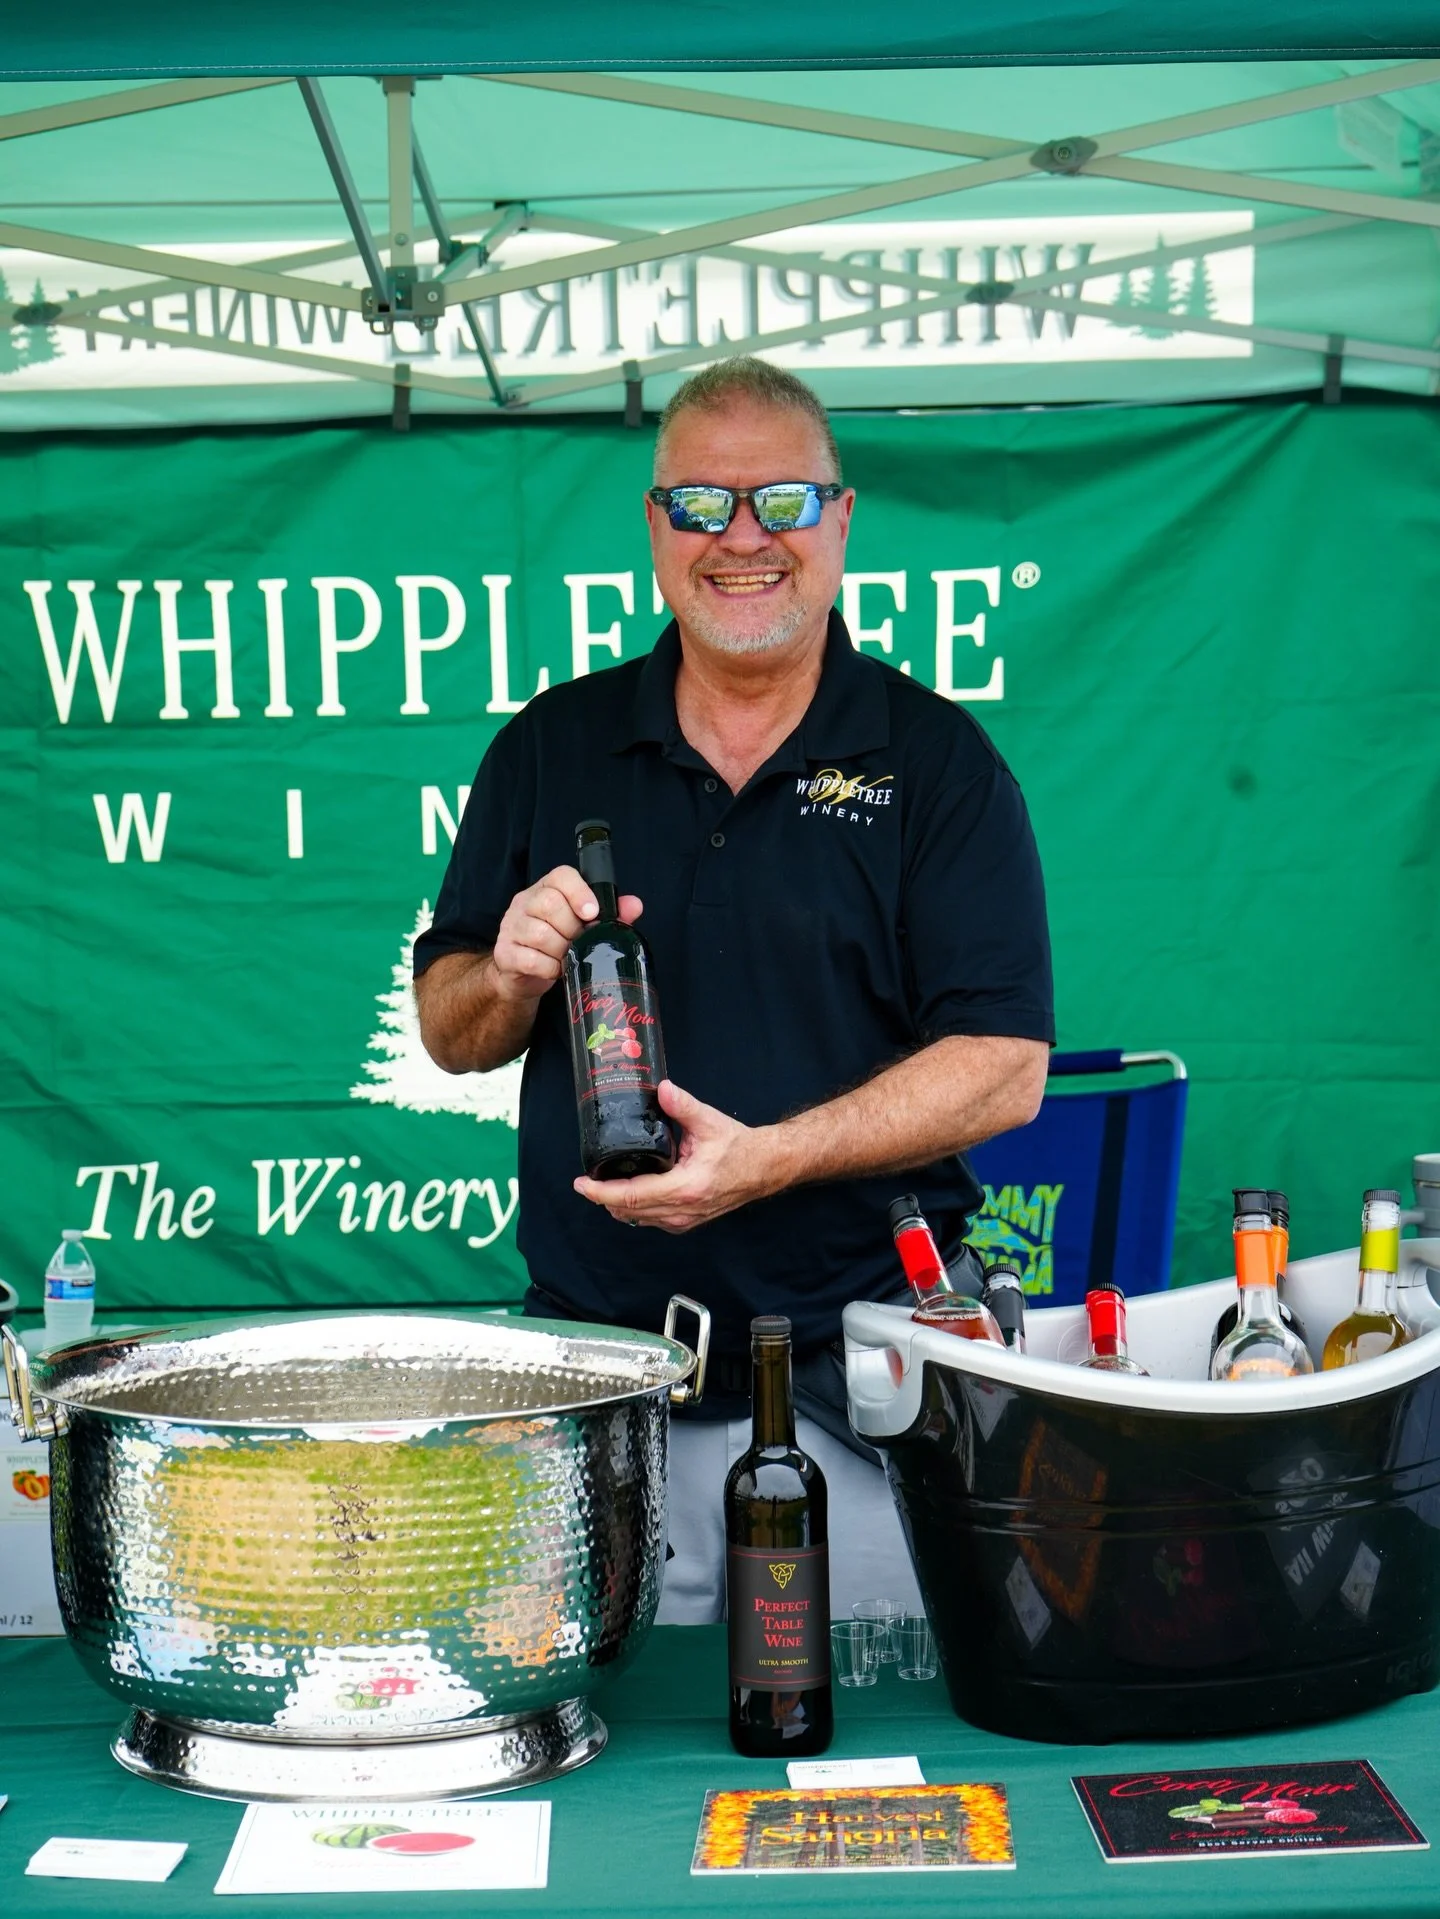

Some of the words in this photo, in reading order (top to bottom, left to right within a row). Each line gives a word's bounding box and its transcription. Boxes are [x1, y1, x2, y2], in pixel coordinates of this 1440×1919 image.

[796, 778, 893, 805] WHIPPLETREE
[800, 803, 874, 826] WINERY
[76, 1160, 216, 1240] The
[252, 1155, 519, 1249] Winery
[979, 1183, 1065, 1244] MMY
[754, 1598, 811, 1612] PERFECT
[20, 1615, 33, 1625] 12
[762, 1616, 804, 1630] TABLE
[764, 1634, 803, 1648] WINE
[781, 1657, 809, 1666] SMOOTH
[790, 1808, 945, 1825] Harvest
[760, 1825, 949, 1847] Sangria
